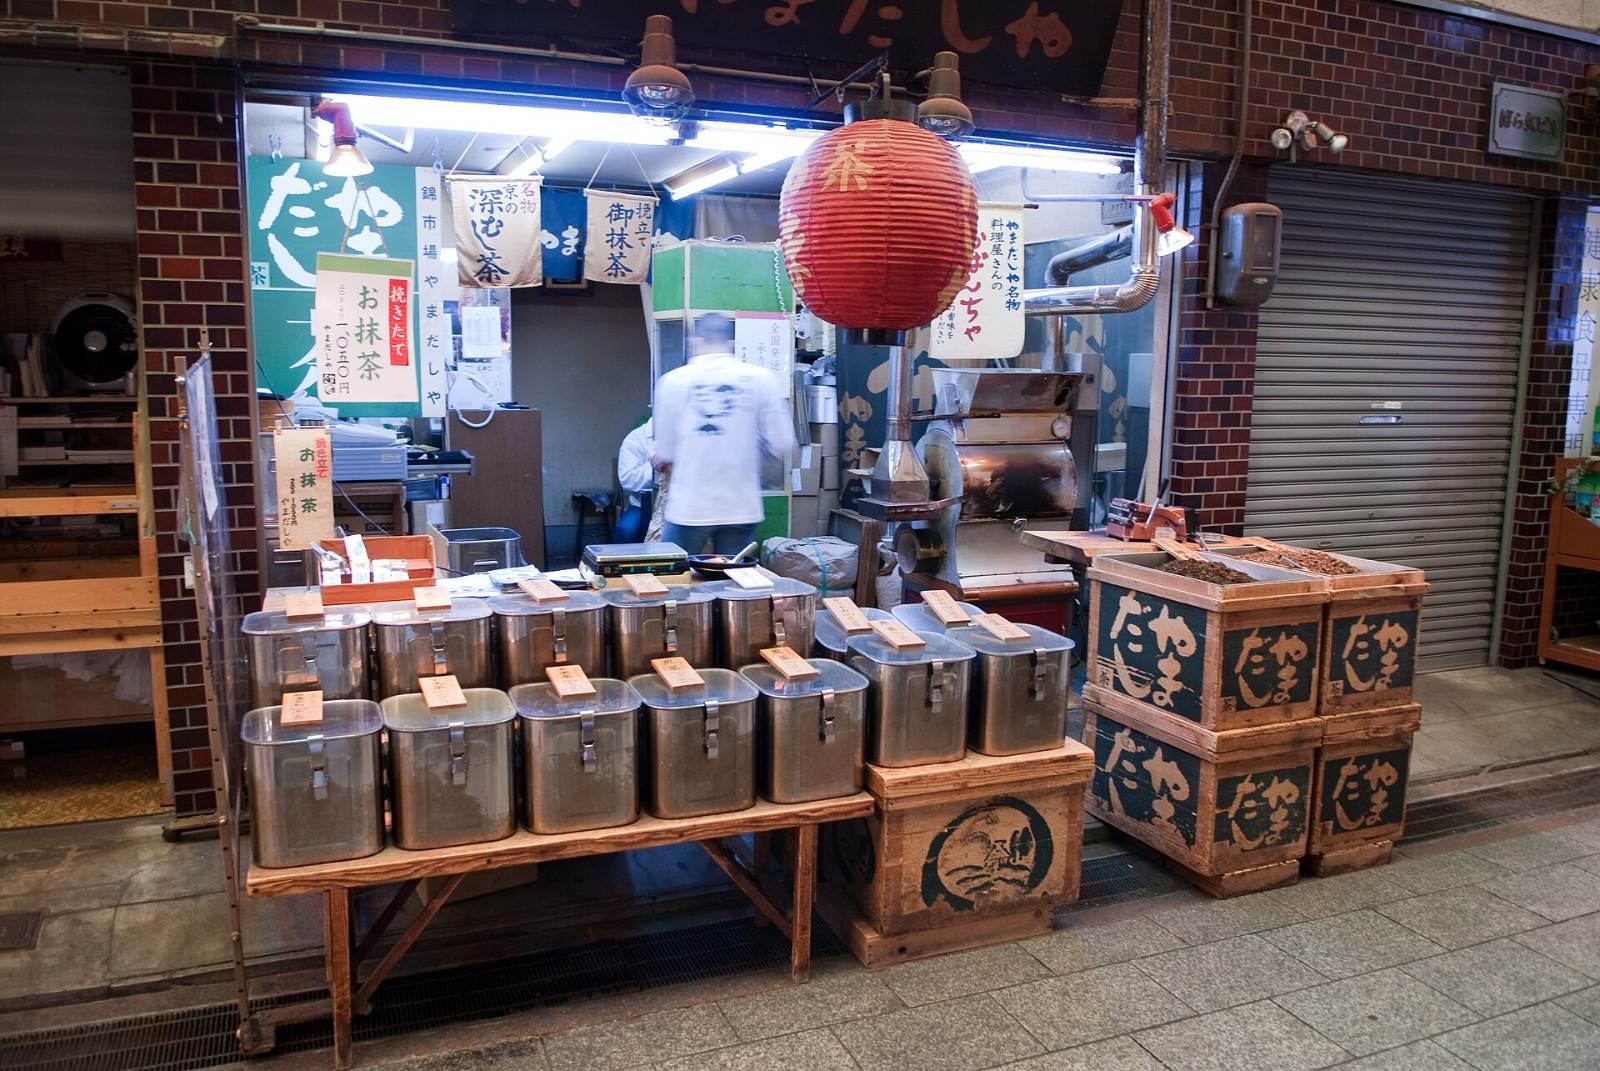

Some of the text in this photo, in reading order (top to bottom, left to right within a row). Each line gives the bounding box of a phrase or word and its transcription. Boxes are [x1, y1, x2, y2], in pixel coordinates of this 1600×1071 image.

[503, 183, 519, 215] 京の
[520, 183, 537, 214] 名物
[819, 138, 879, 192] 茶
[468, 188, 511, 283] 深むし茶
[604, 202, 634, 278] 御抹茶
[989, 217, 1004, 291] 料理屋さんの
[390, 284, 407, 357] 挽きたて
[420, 186, 442, 405] 錦市場やまだしや
[354, 285, 384, 383] お抹茶
[300, 447, 317, 513] お抹茶
[1109, 589, 1152, 698] だし
[1148, 604, 1197, 707] やま
[1234, 627, 1272, 708] だし
[1269, 631, 1308, 702] やま
[1342, 615, 1376, 692] だし
[1373, 619, 1409, 691] やま
[1332, 757, 1367, 830] だし
[1363, 758, 1399, 827] やま
